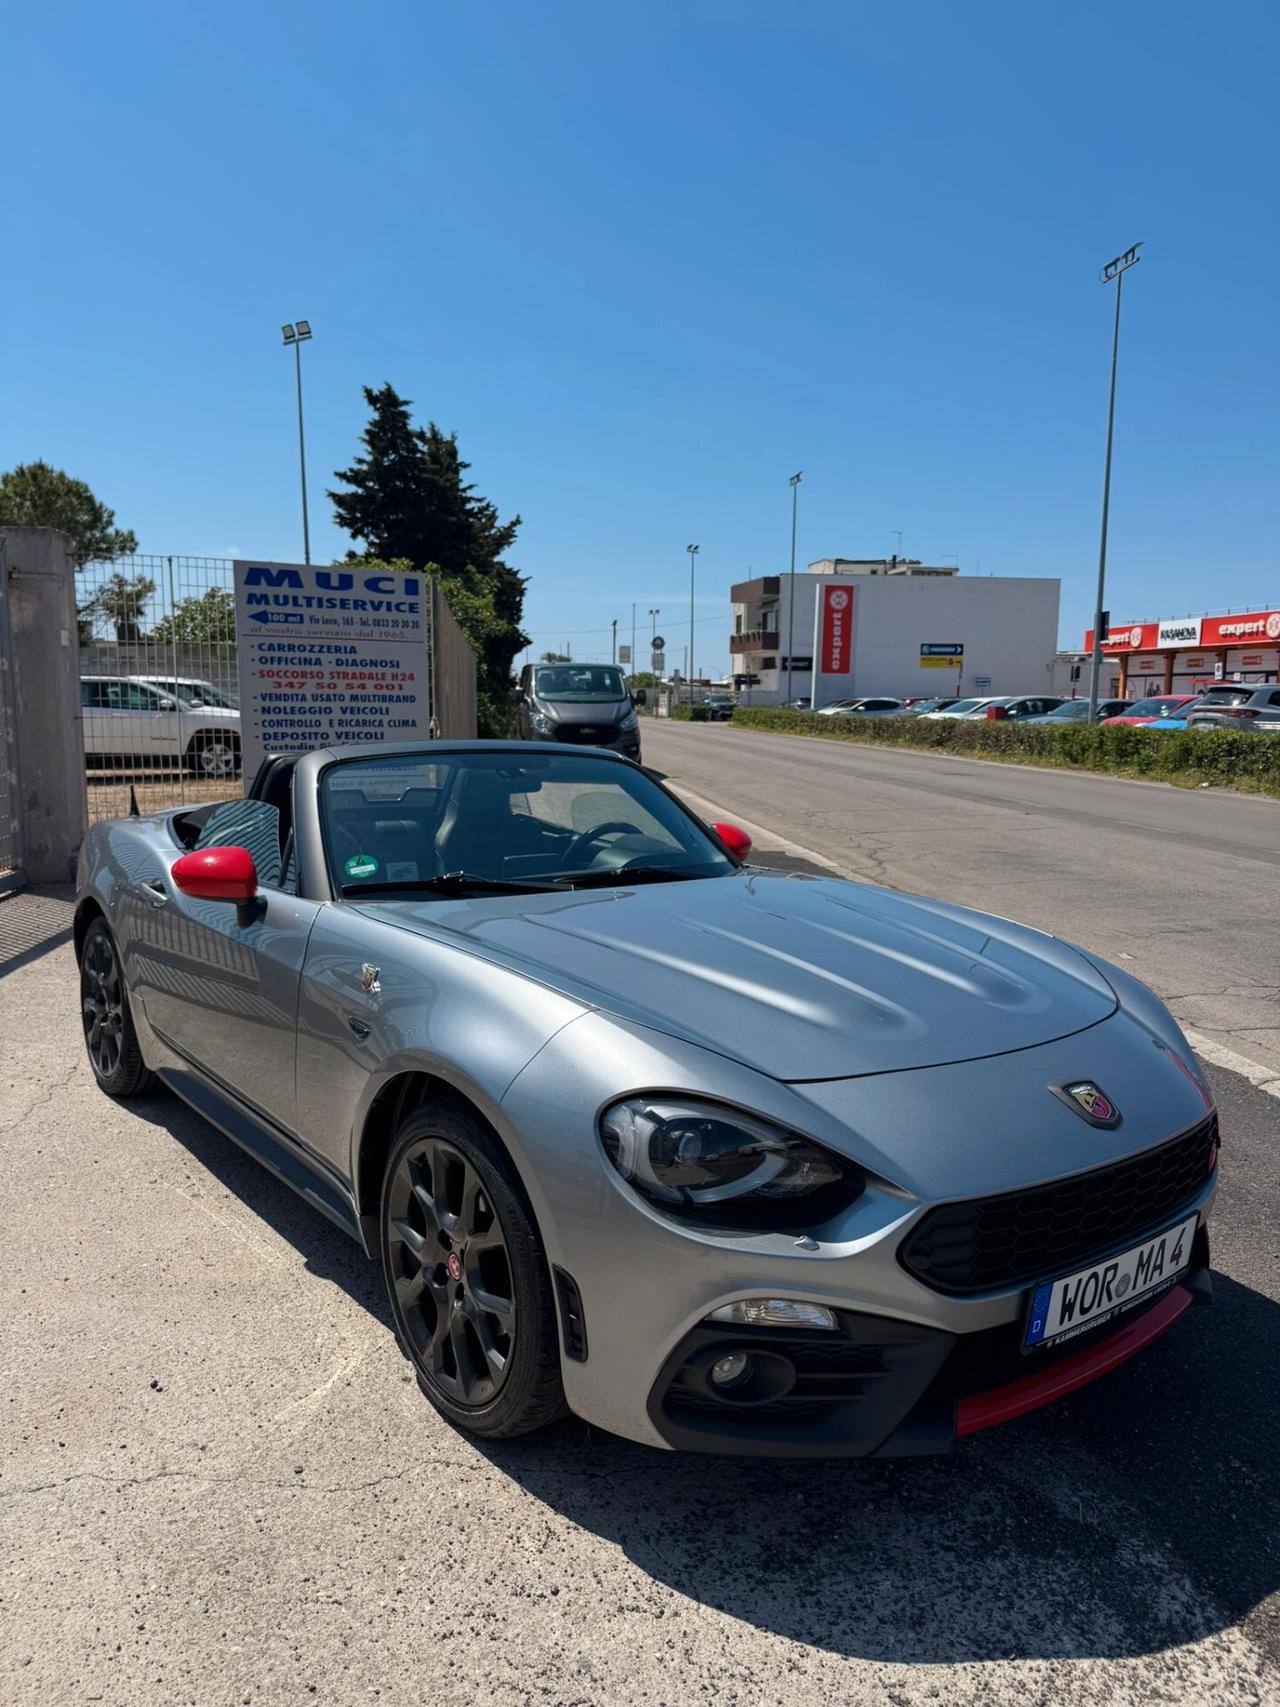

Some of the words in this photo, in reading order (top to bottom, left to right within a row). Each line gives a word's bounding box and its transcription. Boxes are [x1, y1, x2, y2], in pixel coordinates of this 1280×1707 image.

[244, 567, 419, 596] MUCI
[246, 593, 420, 614] MULTISERVICE
[268, 614, 286, 622] 100
[309, 615, 320, 624] Via
[342, 616, 354, 626] 165
[360, 617, 371, 627] Tel.
[372, 618, 389, 628] 0833
[250, 625, 262, 633] al
[266, 627, 303, 635] vostro
[307, 629, 351, 637] servizio
[355, 630, 374, 638] dal
[378, 631, 406, 639] 1965
[1219, 620, 1265, 635] expert
[832, 612, 842, 671] expert
[1100, 632, 1130, 645] pert
[258, 643, 357, 655] CARROZZERIA
[259, 656, 322, 667] OFFICINA
[336, 658, 400, 668] DIAGNOSI
[258, 670, 324, 680] SOCCORSO
[329, 671, 387, 681] STRADALE
[391, 672, 415, 682] H24
[272, 681, 307, 690] 347
[315, 681, 338, 690] 50
[345, 682, 367, 691] 54
[374, 682, 404, 691] 001
[260, 693, 307, 703] VENDITA
[311, 693, 346, 703] USATO
[350, 694, 416, 704] MULTIBRAND
[261, 706, 333, 716] NOLEGGIO
[340, 706, 390, 716] VEICOLI
[261, 719, 321, 728] CONTROLLO
[329, 719, 335, 728] E
[338, 719, 384, 728] RICARICA
[387, 719, 417, 728] CLIMA
[262, 731, 330, 741] DEPOSITO
[335, 731, 385, 741] VEICOLI
[264, 743, 315, 751] Custodia
[1059, 1262, 1119, 1326] WOR
[1132, 1239, 1166, 1291] MA
[1170, 1227, 1187, 1266] 4
[1032, 1320, 1042, 1334] D
